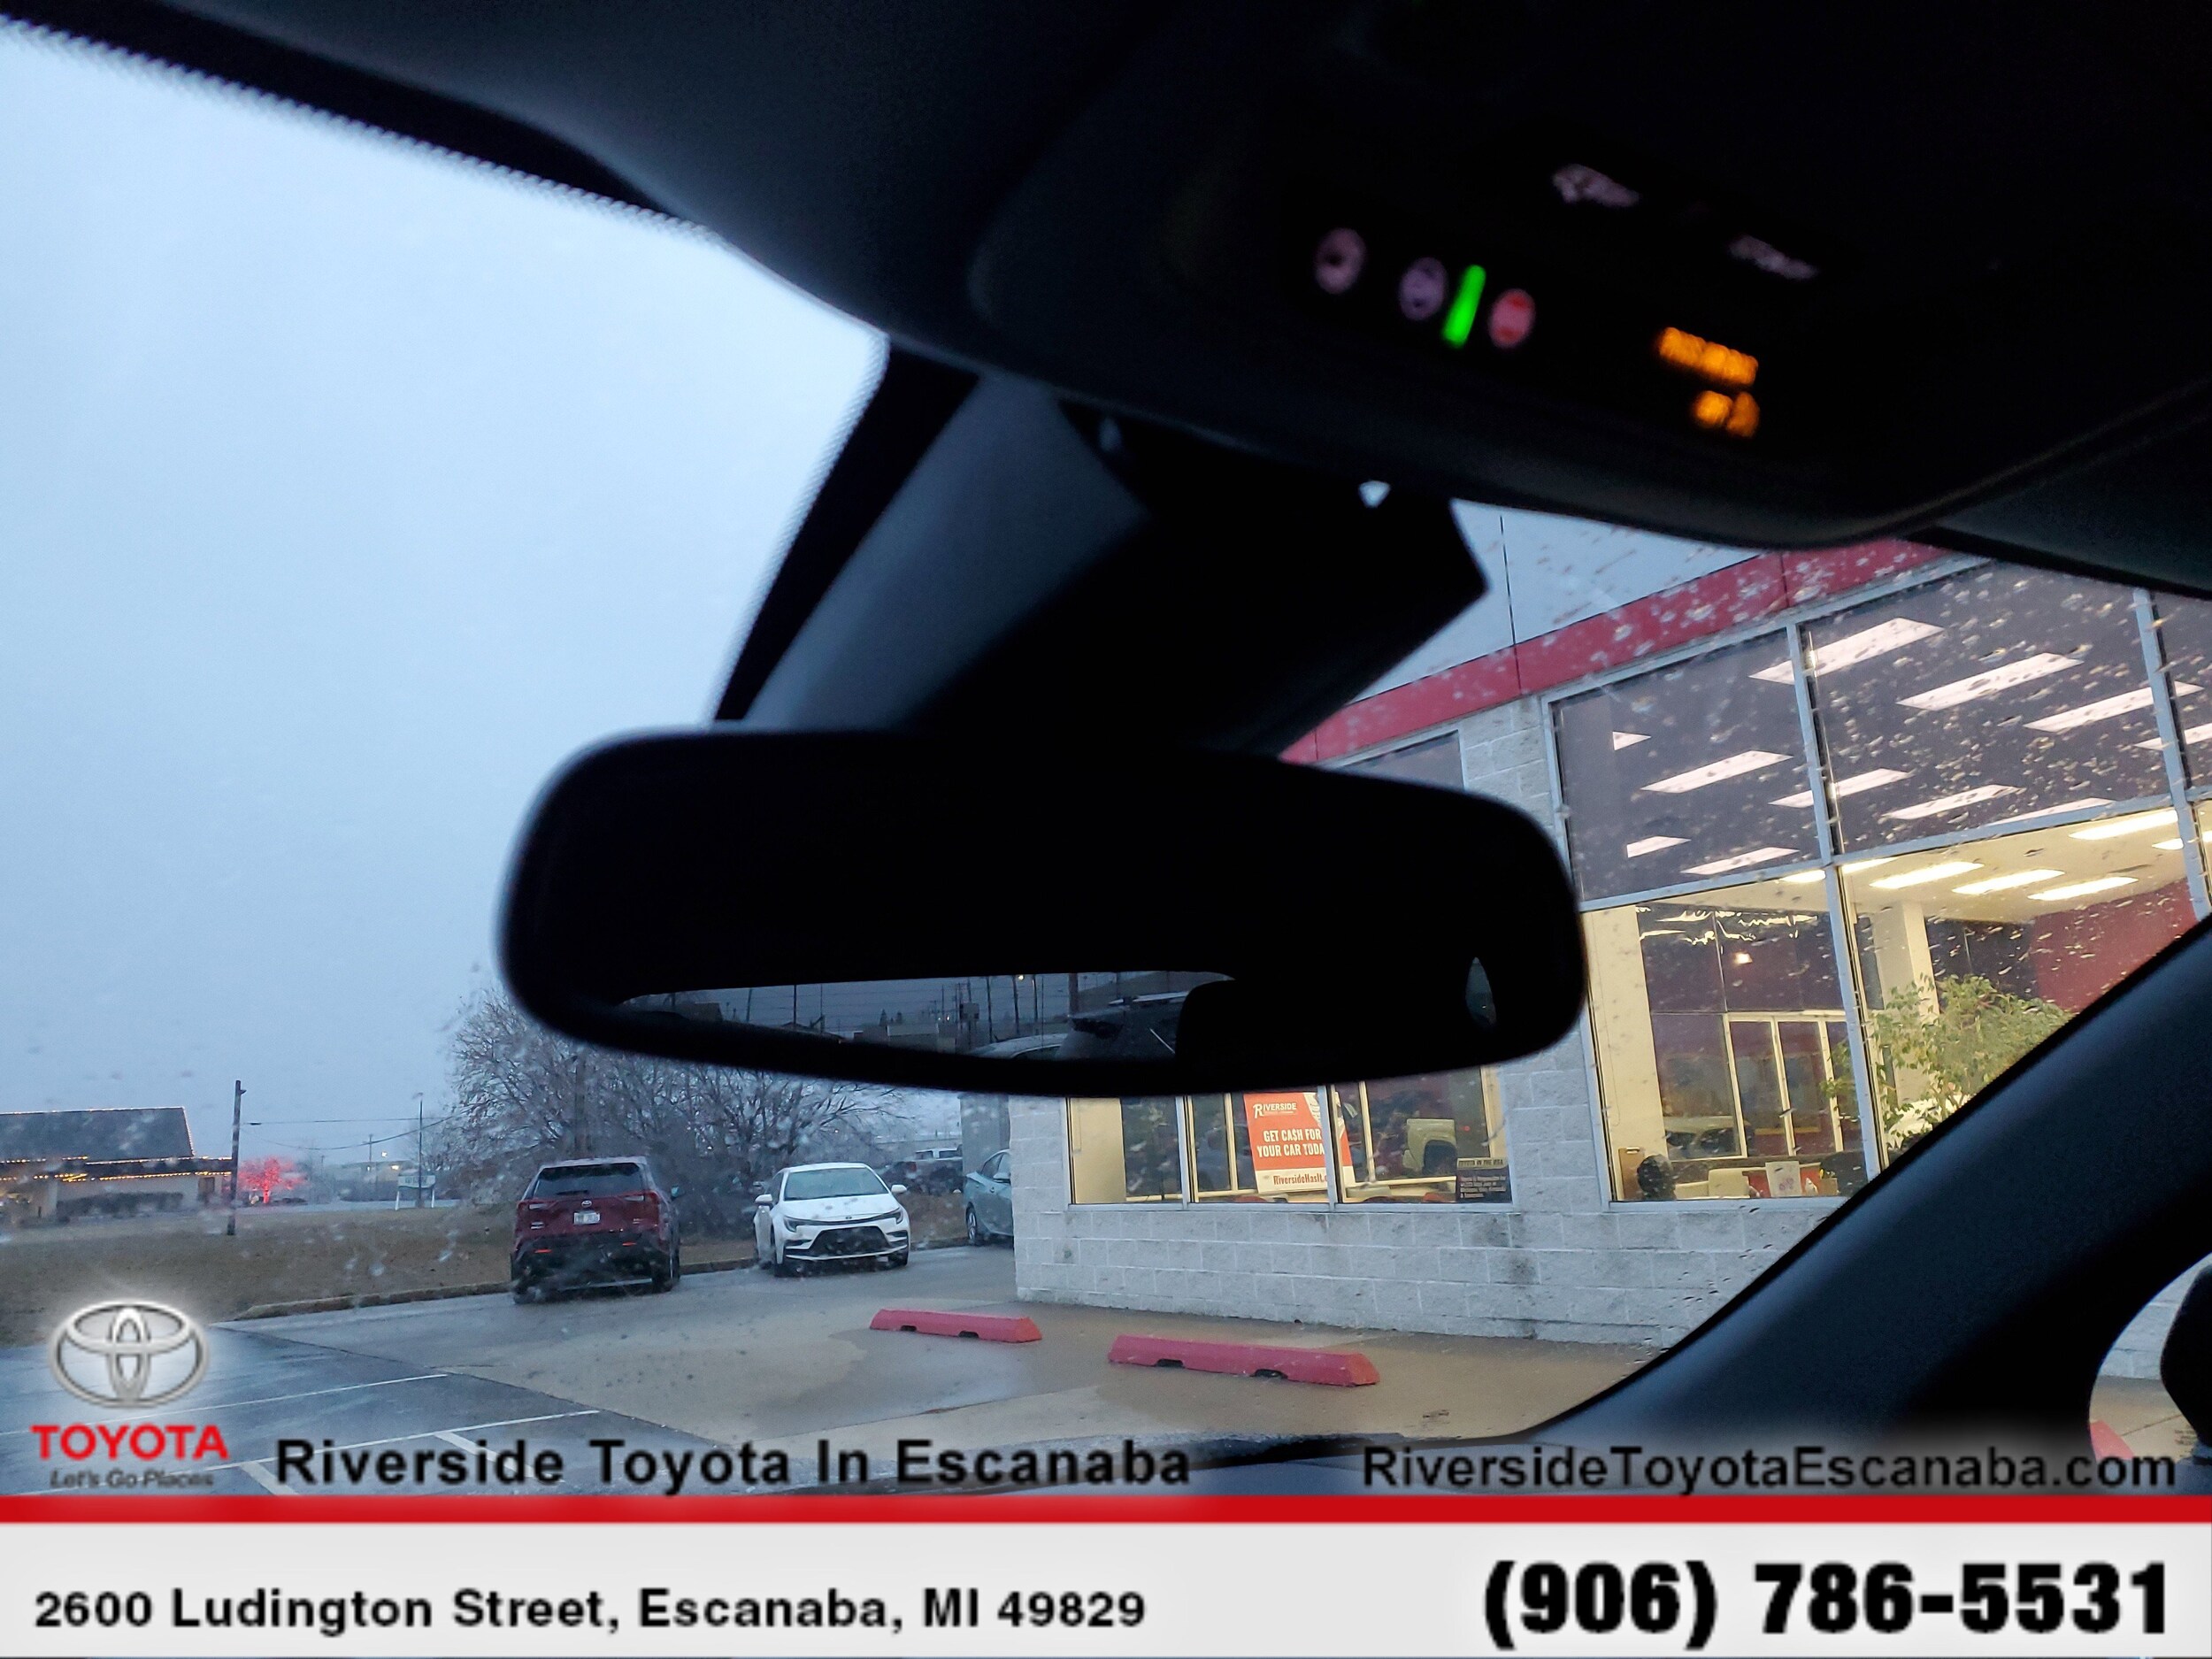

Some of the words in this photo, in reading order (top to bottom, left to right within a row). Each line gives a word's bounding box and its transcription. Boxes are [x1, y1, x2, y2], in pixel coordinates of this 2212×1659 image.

[1253, 1102, 1297, 1118] RIVERSIDE
[1263, 1130, 1279, 1142] GET
[1281, 1128, 1303, 1141] CA$H
[1304, 1128, 1322, 1140] FOR
[1257, 1144, 1282, 1158] YOUR
[1283, 1143, 1302, 1156] CAR
[1302, 1142, 1325, 1155] TODA
[1273, 1172, 1327, 1186] RiversideHasIt.c
